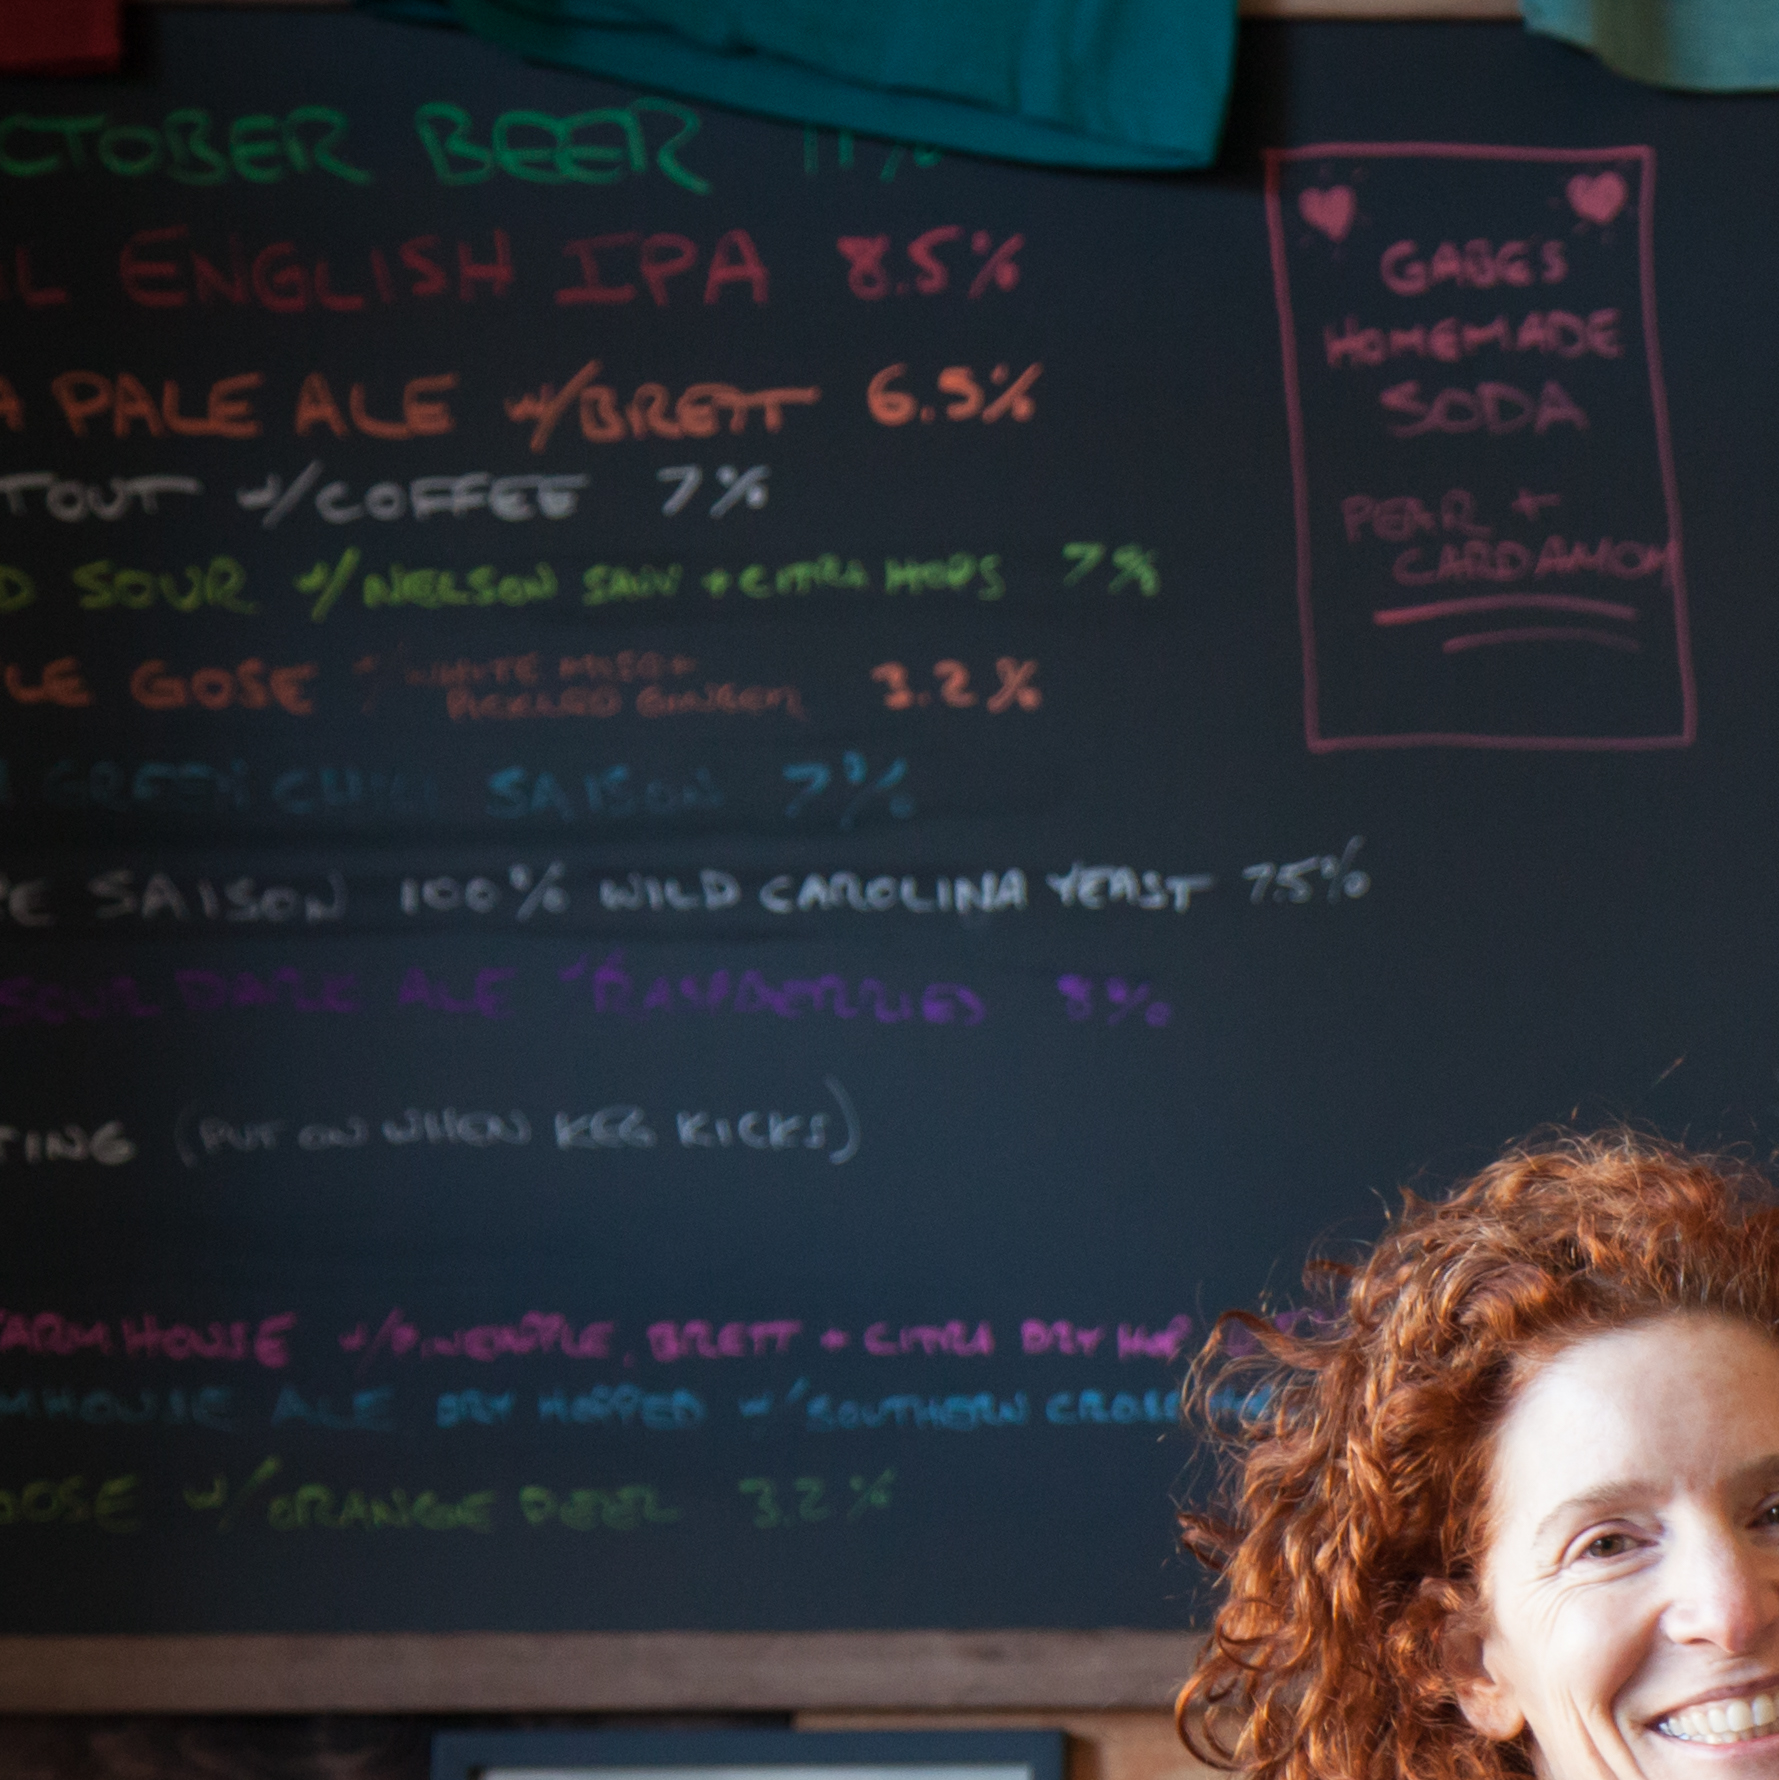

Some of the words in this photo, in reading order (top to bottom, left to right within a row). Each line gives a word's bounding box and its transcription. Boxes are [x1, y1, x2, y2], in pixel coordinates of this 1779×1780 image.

[414, 99, 712, 196] BEER
[117, 224, 516, 313] ENGLISH
[555, 229, 770, 307] IPA
[835, 223, 1027, 302] 8.5%
[1322, 309, 1625, 368] HOMEMADE
[51, 370, 267, 440] PALE
[293, 371, 460, 441] ALE
[865, 361, 1045, 428] 6.5%
[1380, 379, 1593, 438] SODA
[1340, 489, 1492, 543] PEAR
[71, 554, 262, 615] SOUR
[129, 655, 320, 715] GOSE
[87, 868, 348, 923] SAISON
[397, 858, 573, 923] 100%
[599, 869, 740, 912] WILD
[759, 868, 1030, 916] CAROLINA
[1045, 861, 1220, 915] YEAST
[298, 1112, 369, 1152] ON
[554, 1106, 657, 1152] KEG
[645, 1319, 803, 1363] BRETT
[268, 1384, 398, 1434] ALE
